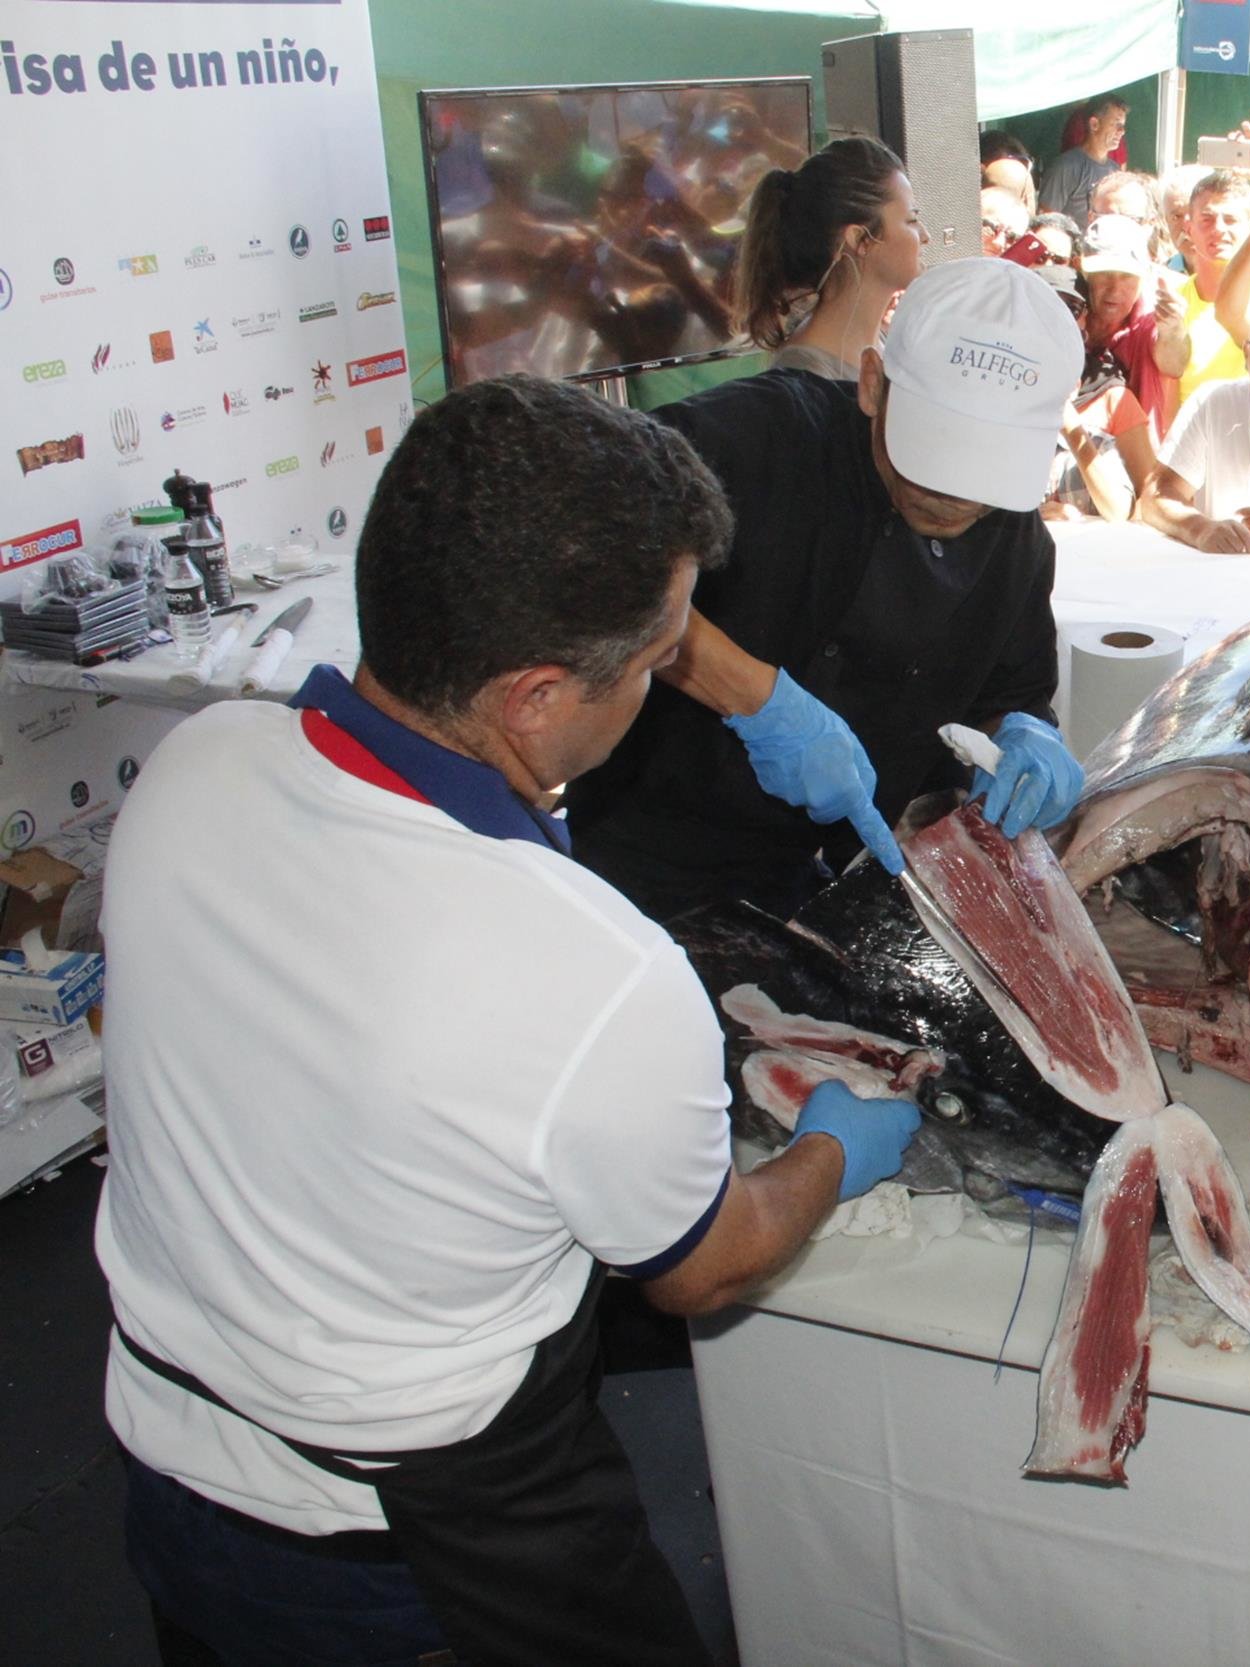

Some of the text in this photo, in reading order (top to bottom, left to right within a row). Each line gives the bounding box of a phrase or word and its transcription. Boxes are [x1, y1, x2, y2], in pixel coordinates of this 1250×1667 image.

[0, 37, 340, 96] isa de un niño,
[22, 359, 67, 383] ereza
[950, 346, 1039, 388] BALFEGO
[264, 455, 300, 478] ereza
[24, 1045, 47, 1066] G
